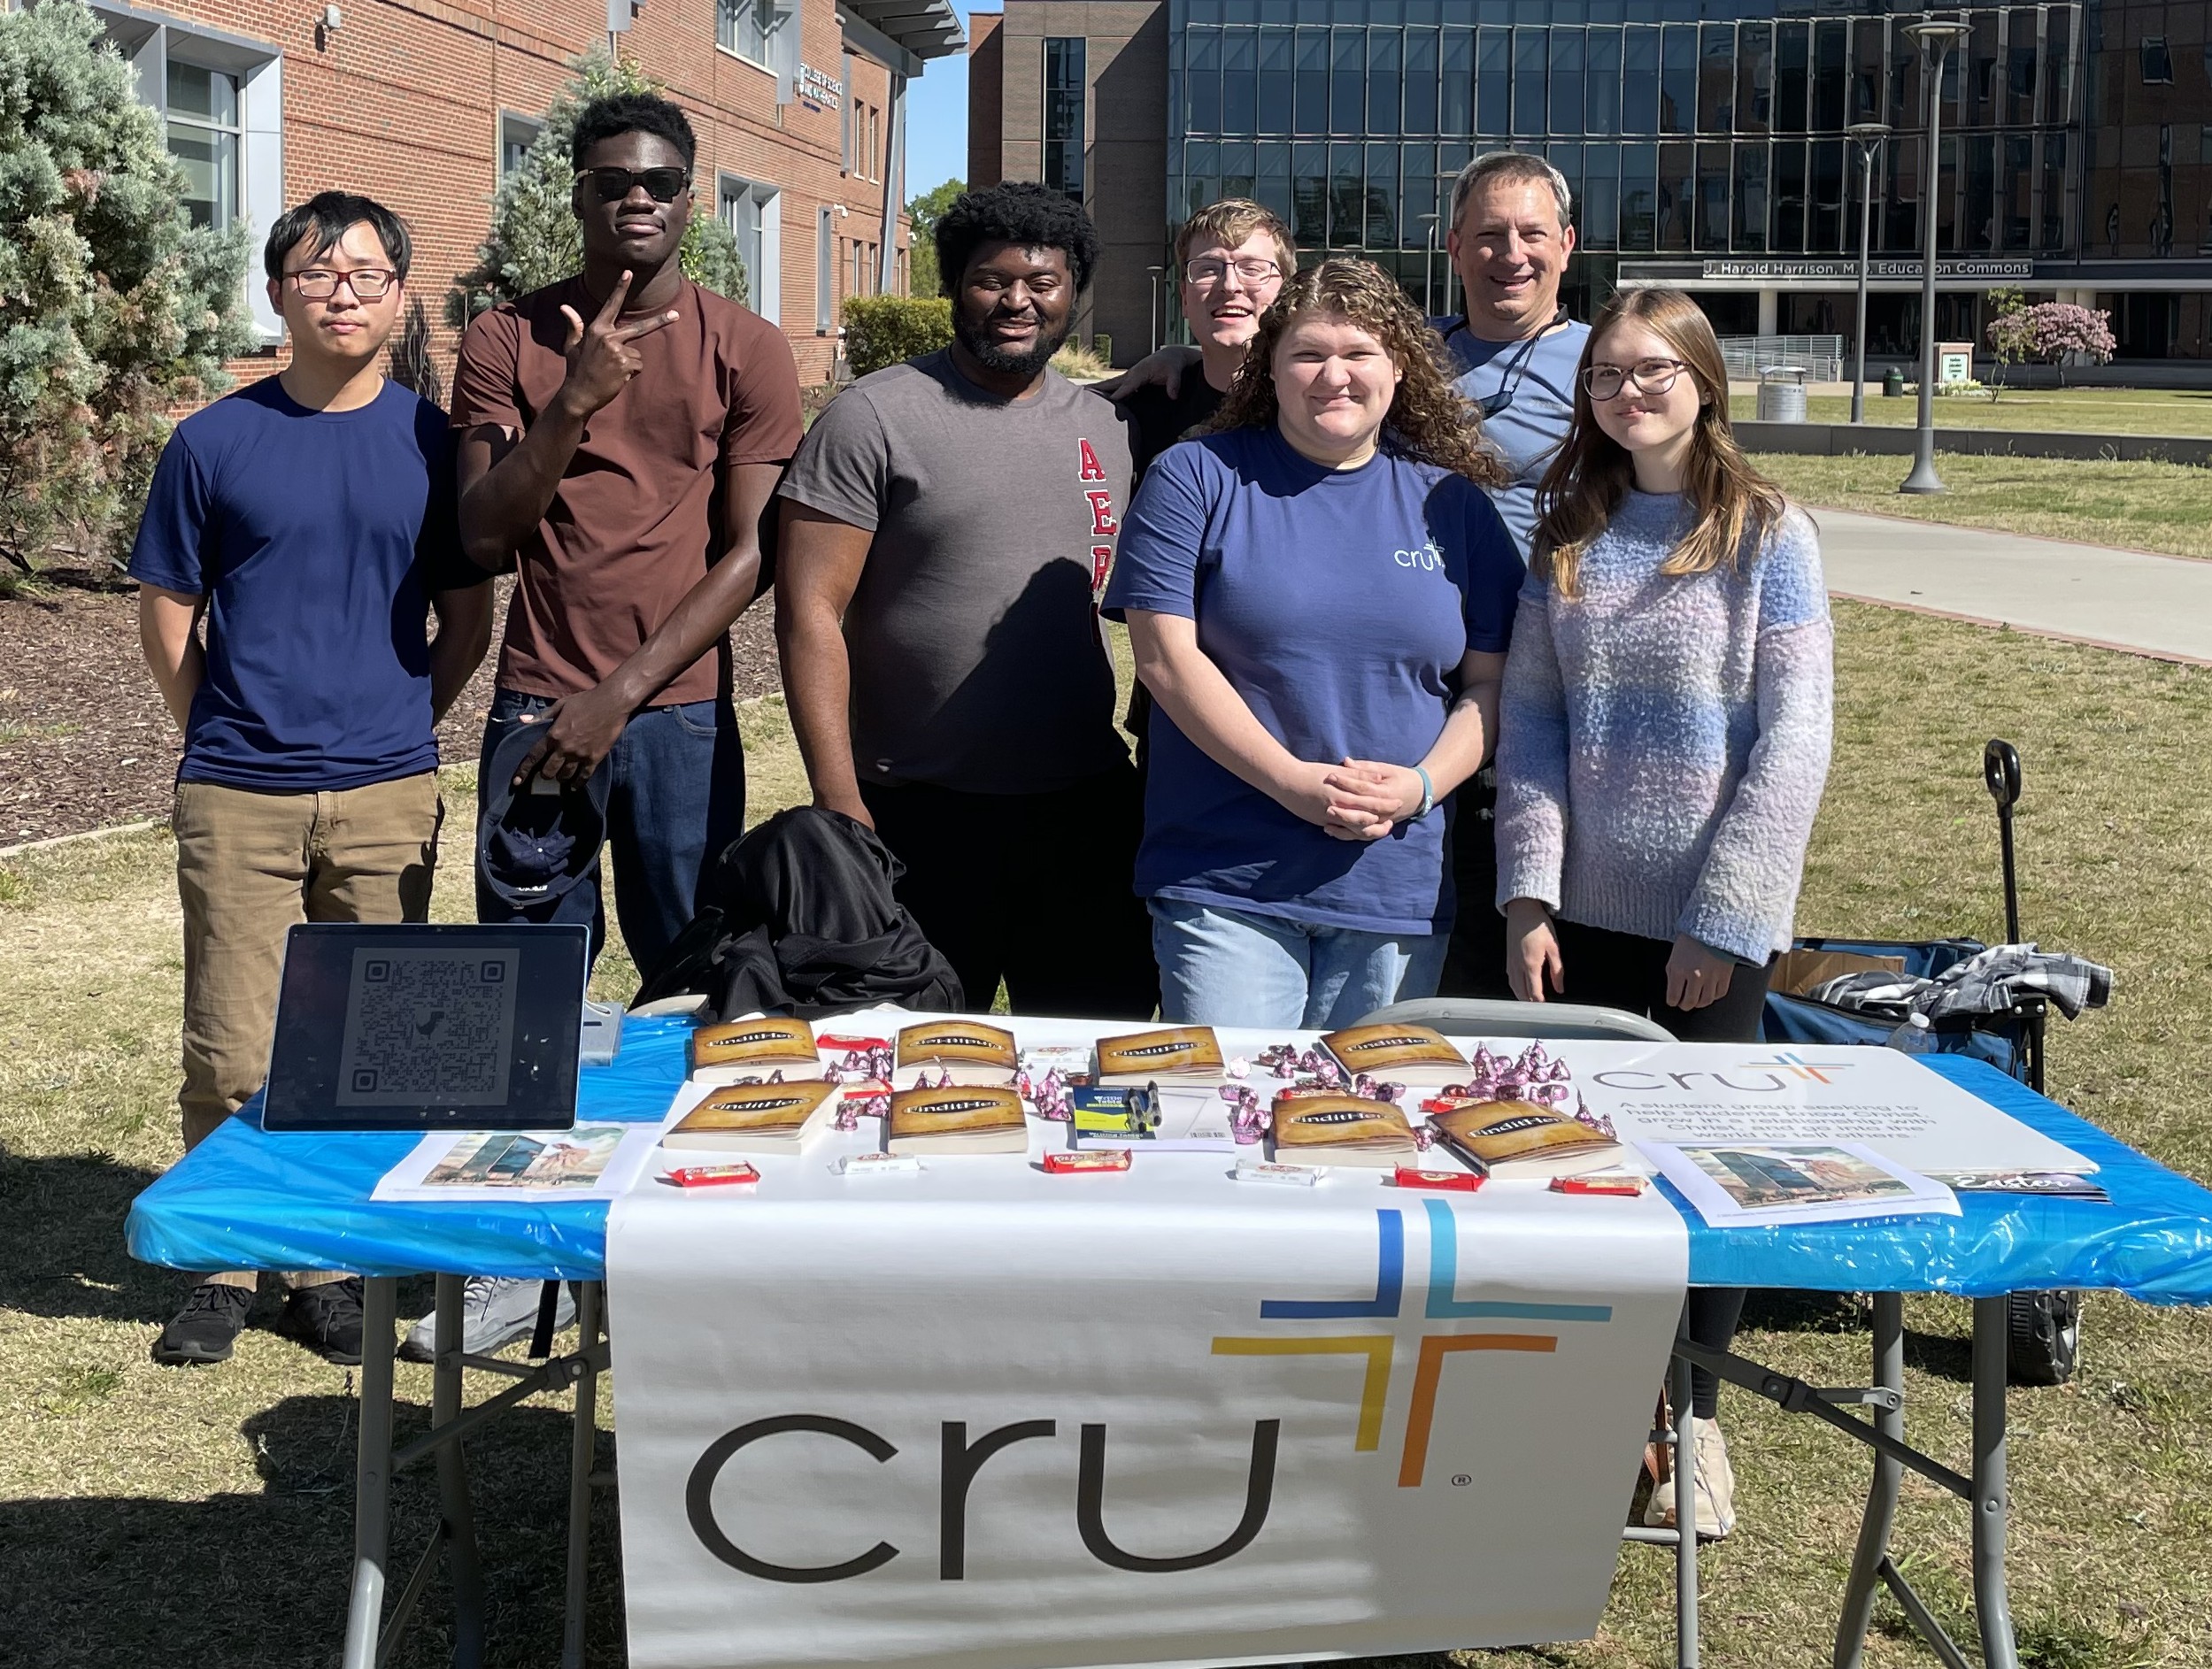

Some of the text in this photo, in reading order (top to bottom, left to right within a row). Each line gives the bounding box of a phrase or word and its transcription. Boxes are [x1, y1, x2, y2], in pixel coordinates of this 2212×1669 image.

[1704, 263, 1716, 273] J.
[1721, 263, 1769, 273] Harold
[1774, 263, 1838, 275] Harrison,
[1878, 263, 1951, 274] Educaon
[1956, 262, 2029, 273] Commons
[1394, 550, 1434, 571] cru
[1592, 1071, 1786, 1091] cru
[686, 1413, 1280, 1583] cru
